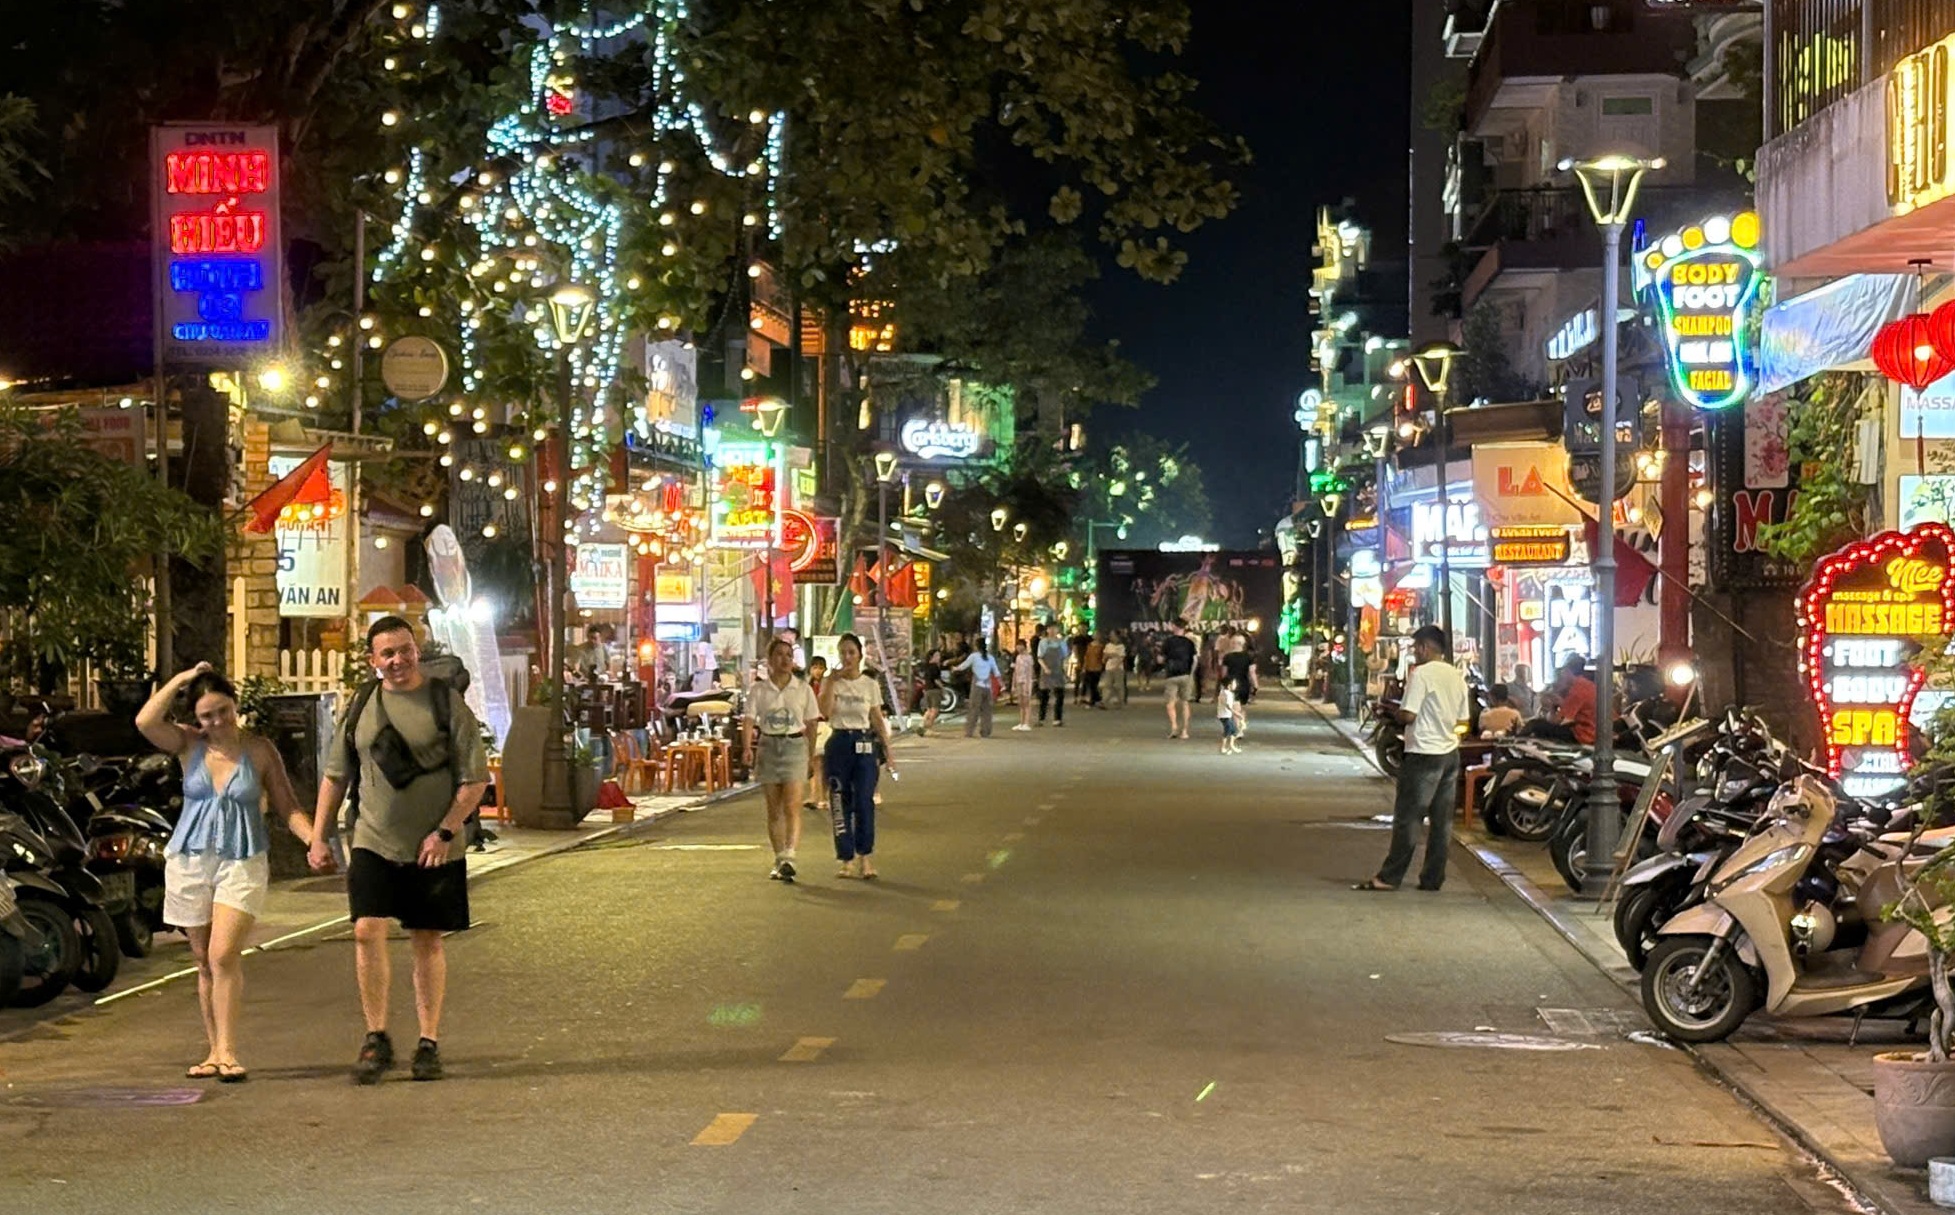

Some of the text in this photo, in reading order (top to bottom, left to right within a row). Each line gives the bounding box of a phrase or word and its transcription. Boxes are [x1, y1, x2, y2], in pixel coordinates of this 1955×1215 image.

[185, 132, 244, 146] DNTN
[167, 153, 267, 194] MINH
[170, 197, 264, 254] HIẾU
[1672, 263, 1740, 285] BODY
[1673, 285, 1741, 309] FOOT
[1673, 315, 1732, 336] SHAMPOO
[1690, 370, 1732, 391] FACIAL
[1906, 396, 1955, 411] MASS
[901, 419, 978, 458] Carlsberg
[315, 586, 340, 606] AN
[1825, 603, 1942, 634] MASSAGE
[1833, 640, 1901, 667] FOOT
[1832, 675, 1907, 704] BODY
[1832, 709, 1896, 746] SPA
